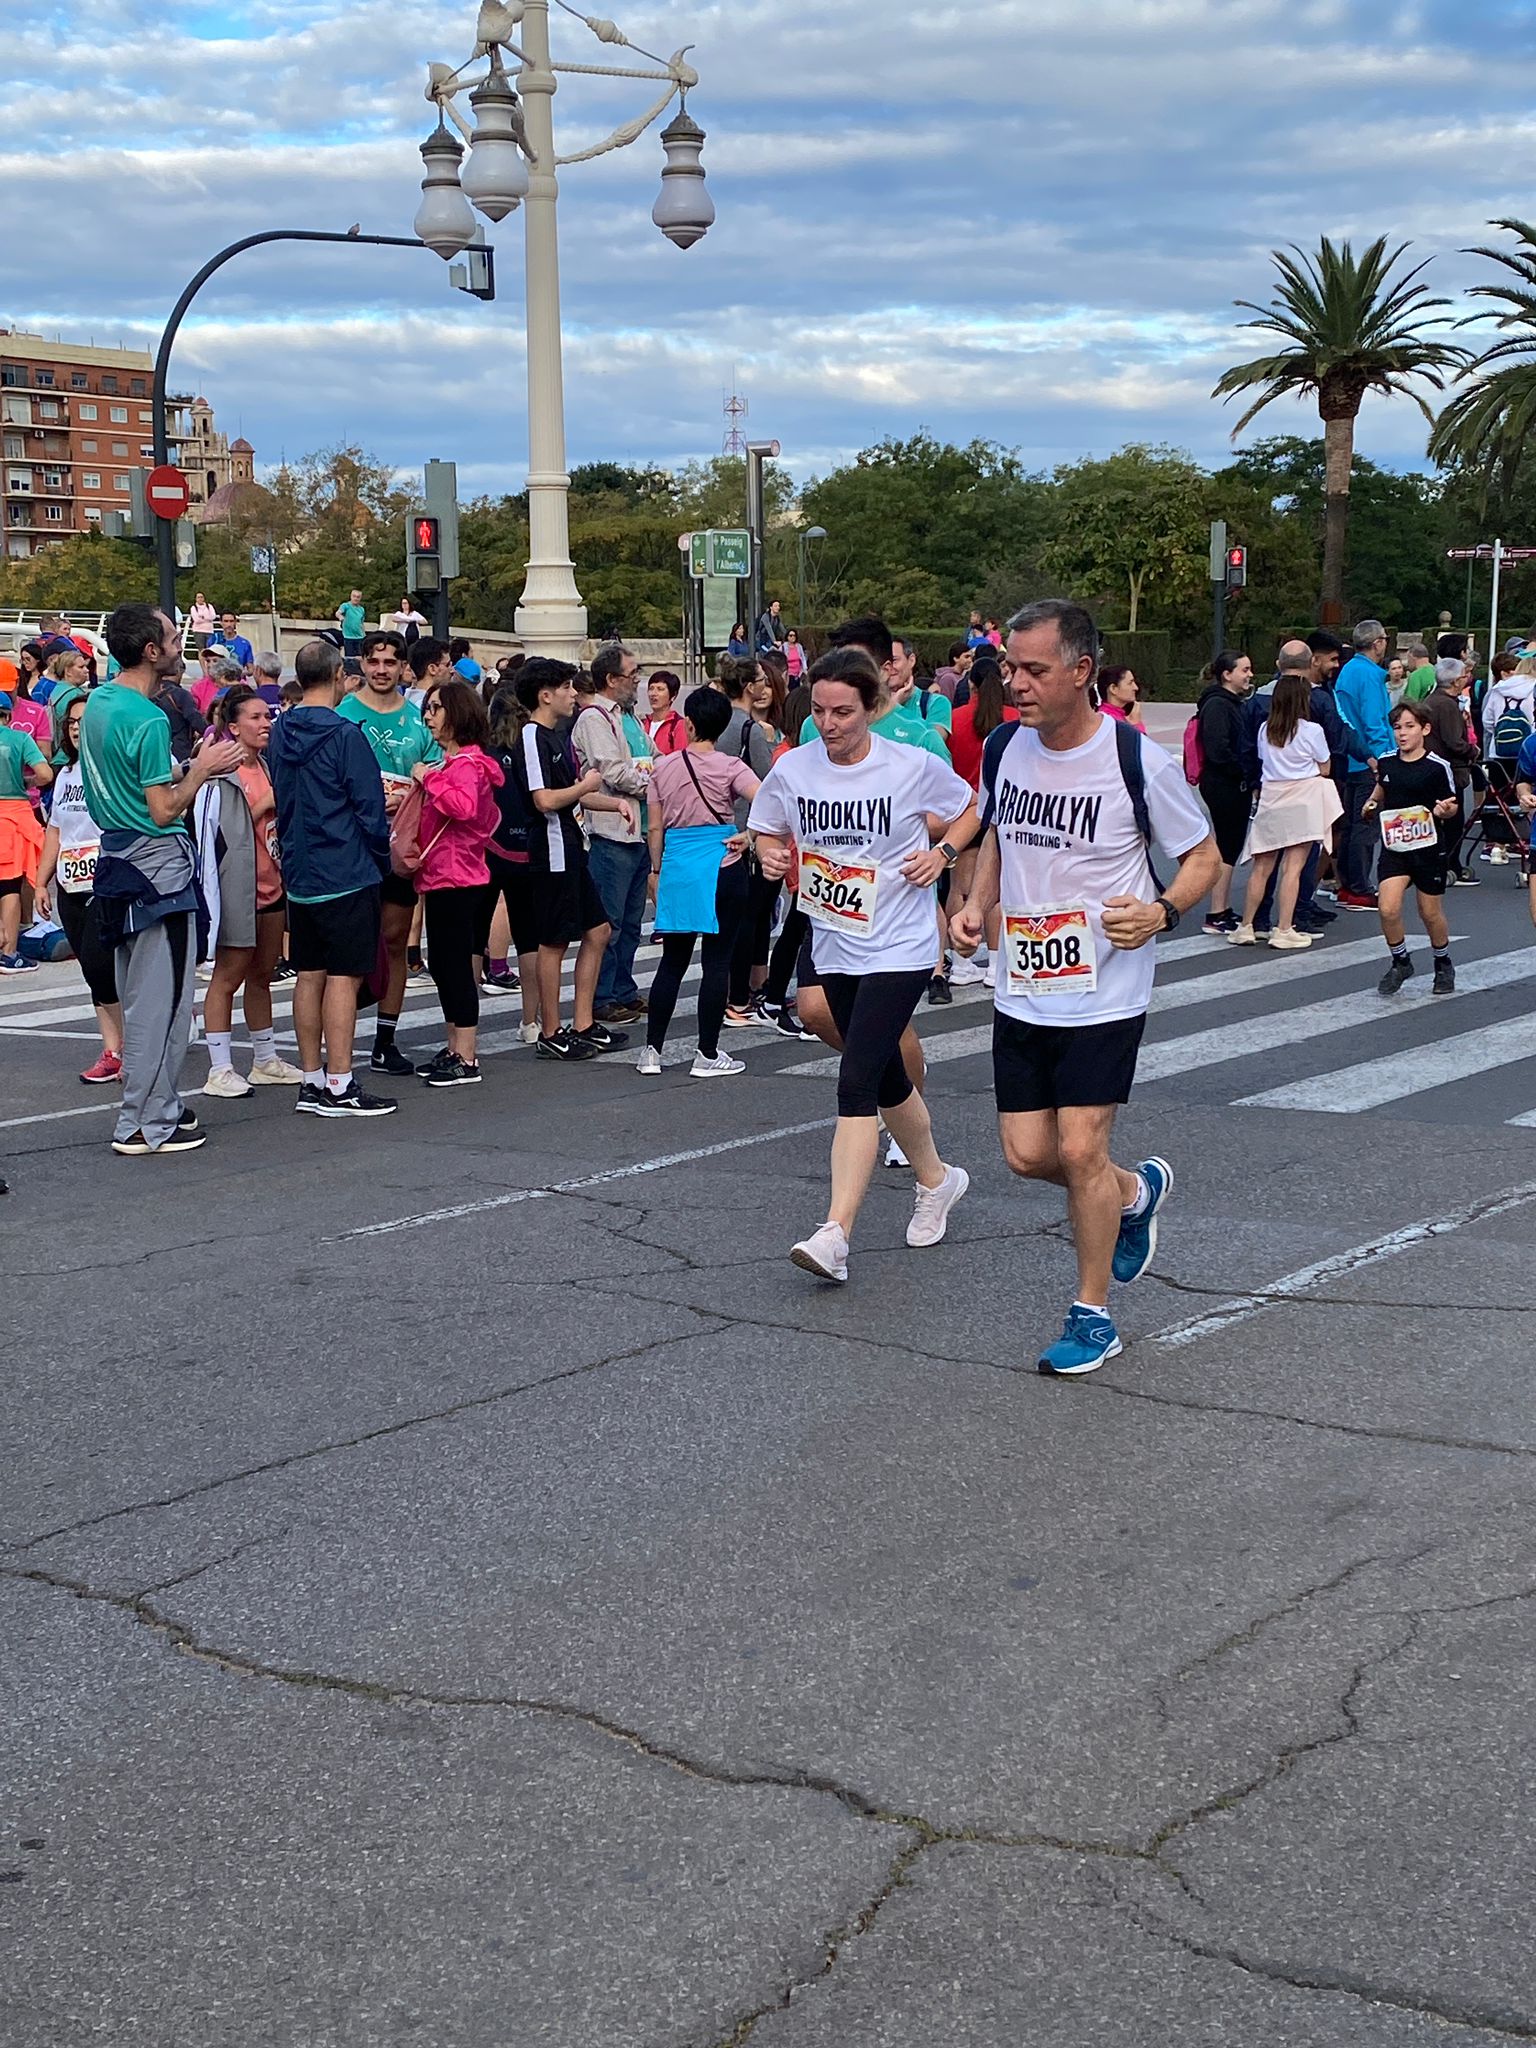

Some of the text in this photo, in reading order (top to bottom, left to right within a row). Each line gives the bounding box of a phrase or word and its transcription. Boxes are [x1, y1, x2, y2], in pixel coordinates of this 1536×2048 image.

[797, 796, 892, 837] BROOKLYN
[998, 778, 1102, 843] BROOKLYN
[822, 835, 864, 846] FITBOXING
[1015, 831, 1060, 849] FITBOXING
[64, 859, 96, 879] 5298
[809, 872, 863, 913] 3304
[1016, 935, 1081, 971] 3508
